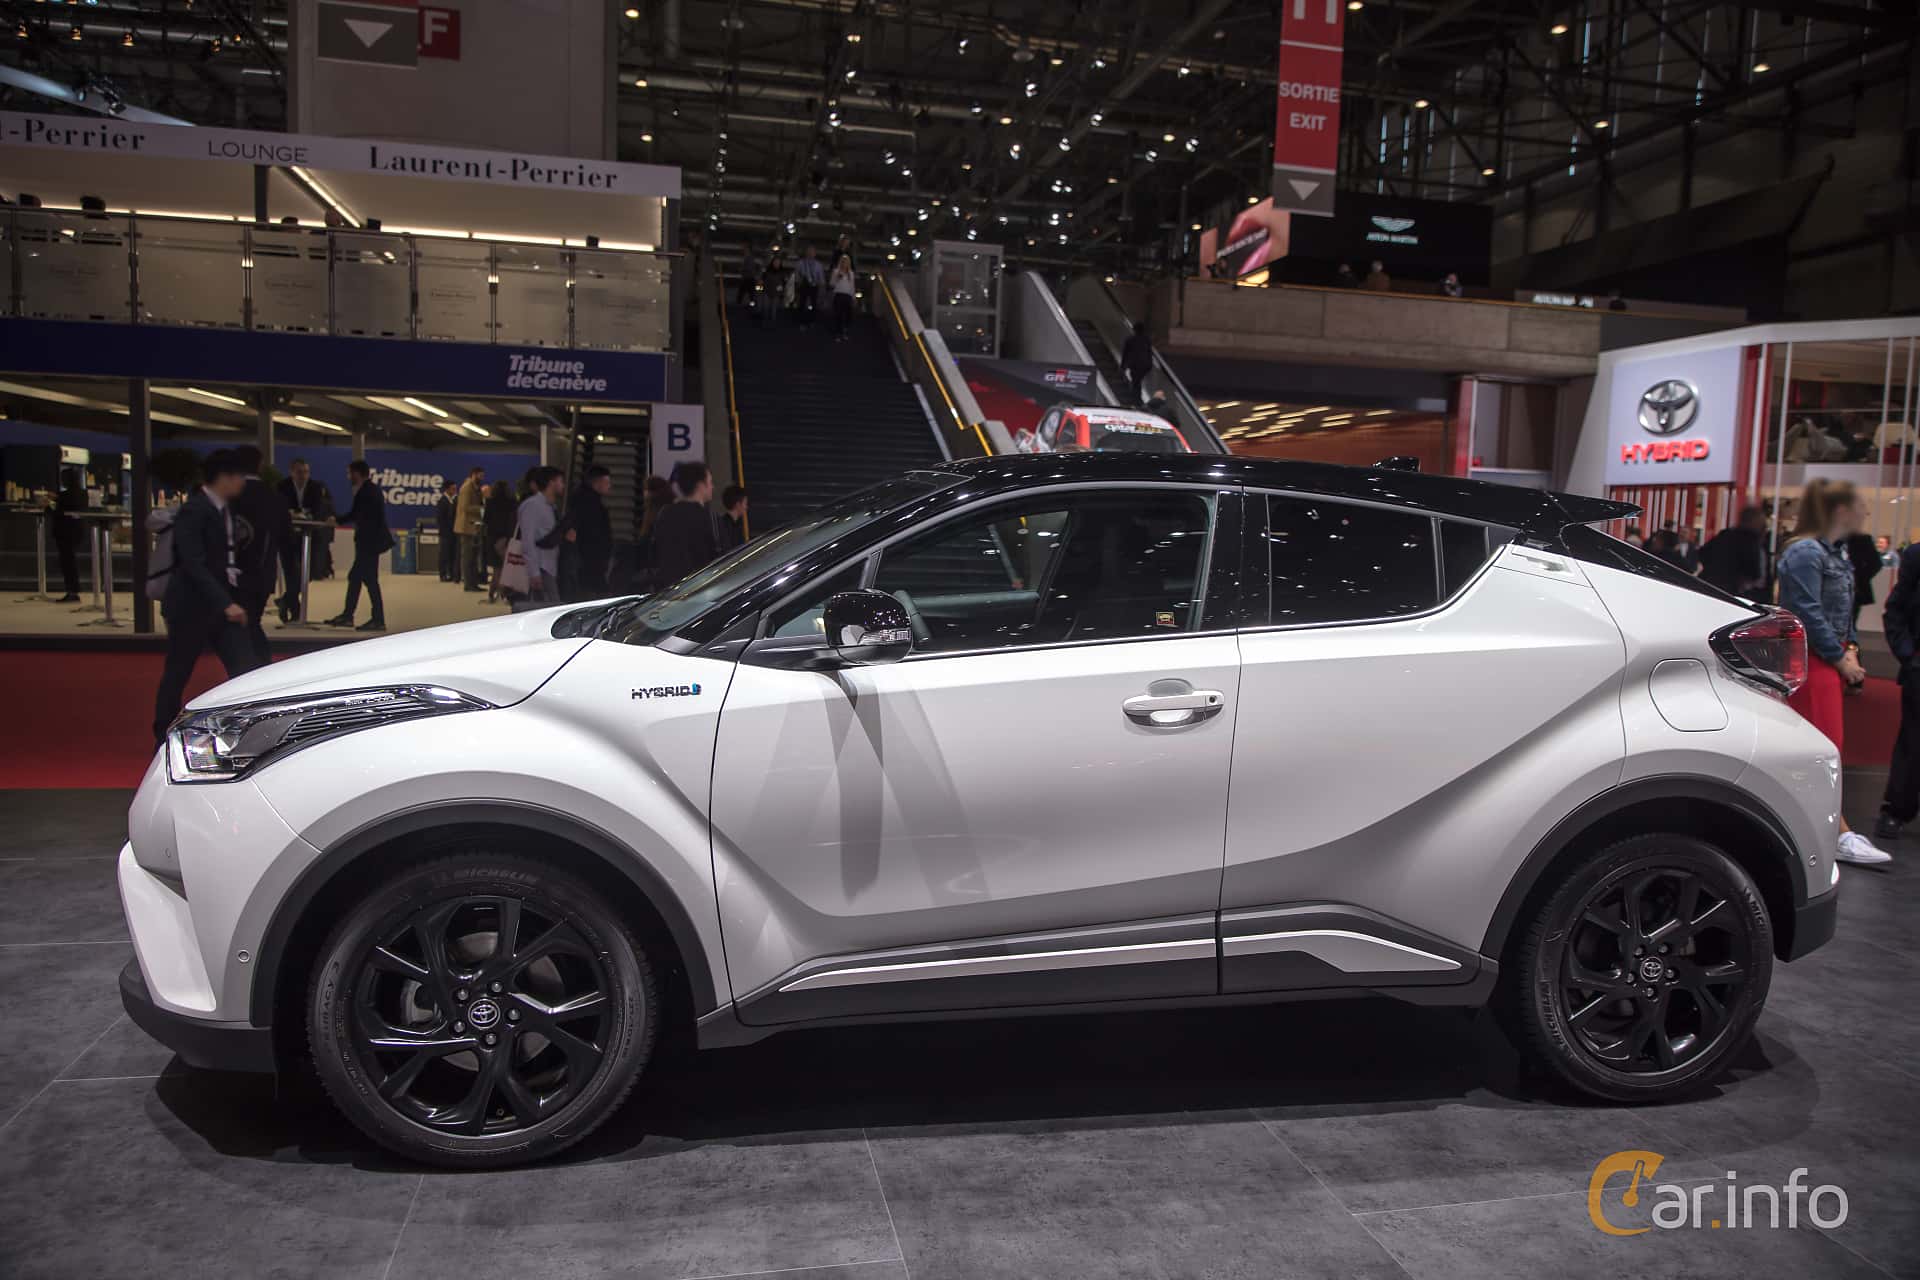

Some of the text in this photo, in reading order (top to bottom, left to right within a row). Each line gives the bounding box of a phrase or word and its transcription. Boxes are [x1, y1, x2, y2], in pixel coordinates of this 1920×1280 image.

[423, 10, 449, 45] F
[1279, 81, 1341, 103] SORTIE
[1289, 111, 1328, 131] EXIT
[0, 119, 146, 151] -Perrier
[208, 140, 309, 164] LOUNGE
[369, 145, 618, 190] Laurent-Perrier
[509, 354, 585, 375] Tribune
[507, 371, 608, 392] deGenève
[667, 423, 692, 451] B
[1621, 439, 1710, 464] HYBRID
[382, 487, 443, 507] Genè
[631, 684, 691, 700] HYBRID
